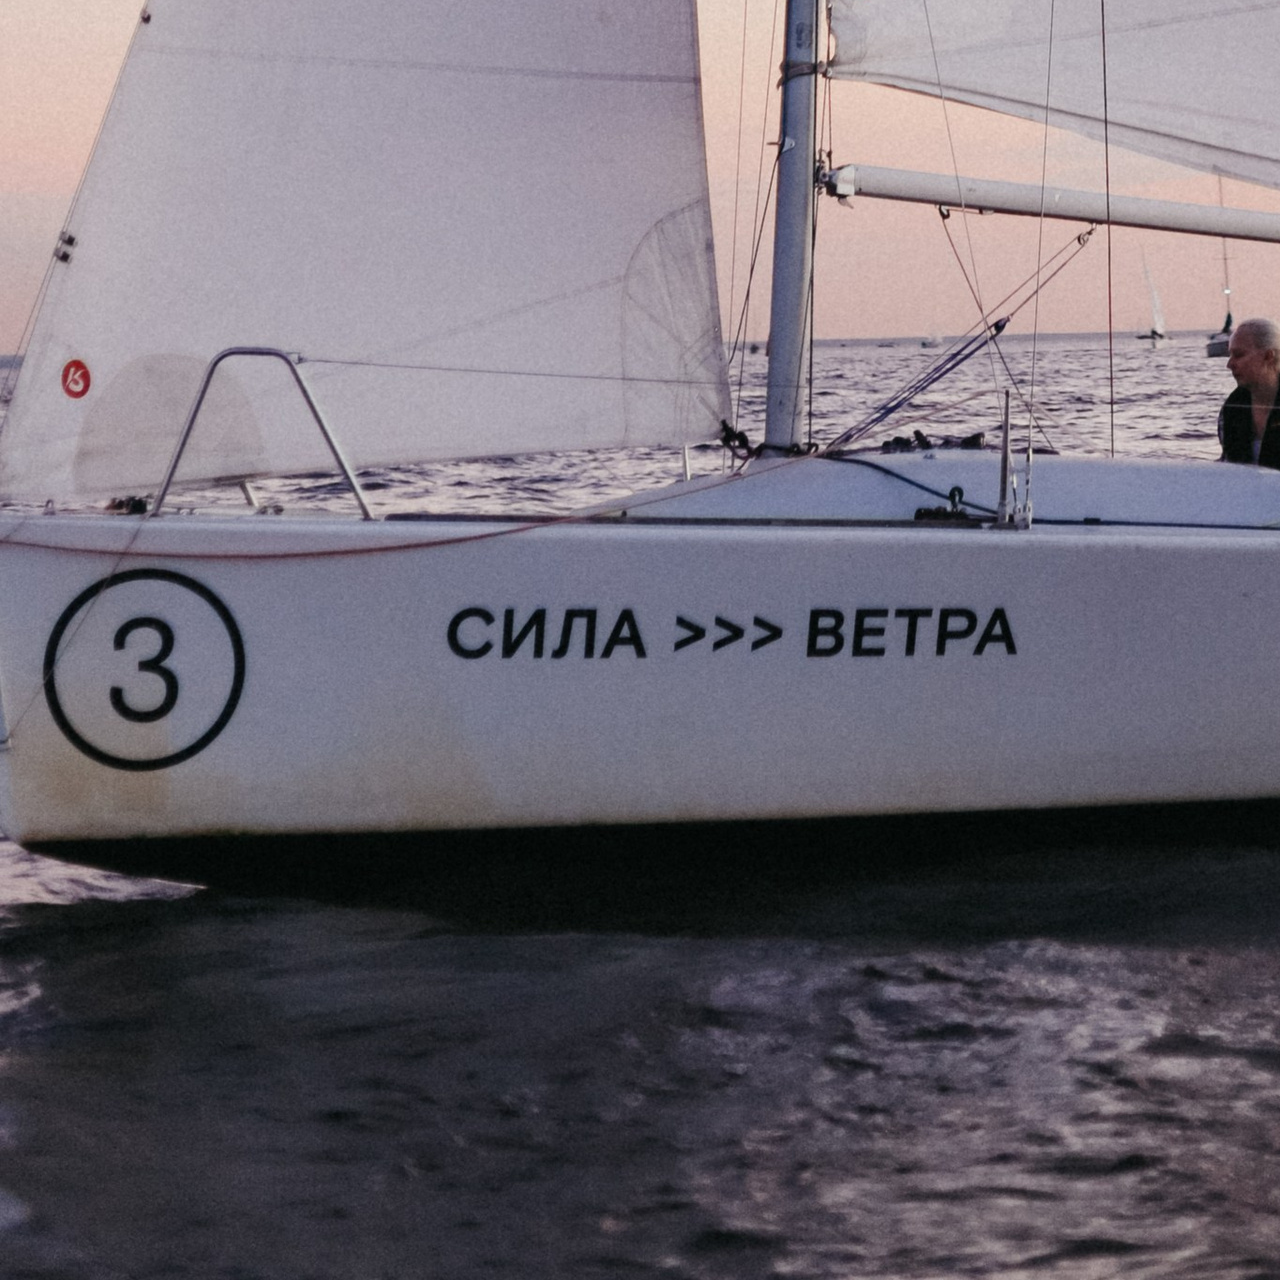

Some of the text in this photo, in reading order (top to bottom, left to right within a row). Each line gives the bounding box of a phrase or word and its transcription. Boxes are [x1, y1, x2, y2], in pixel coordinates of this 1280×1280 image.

[109, 616, 179, 723] 3
[446, 606, 648, 660] СИЛА
[806, 606, 1018, 658] ВЕТРА
